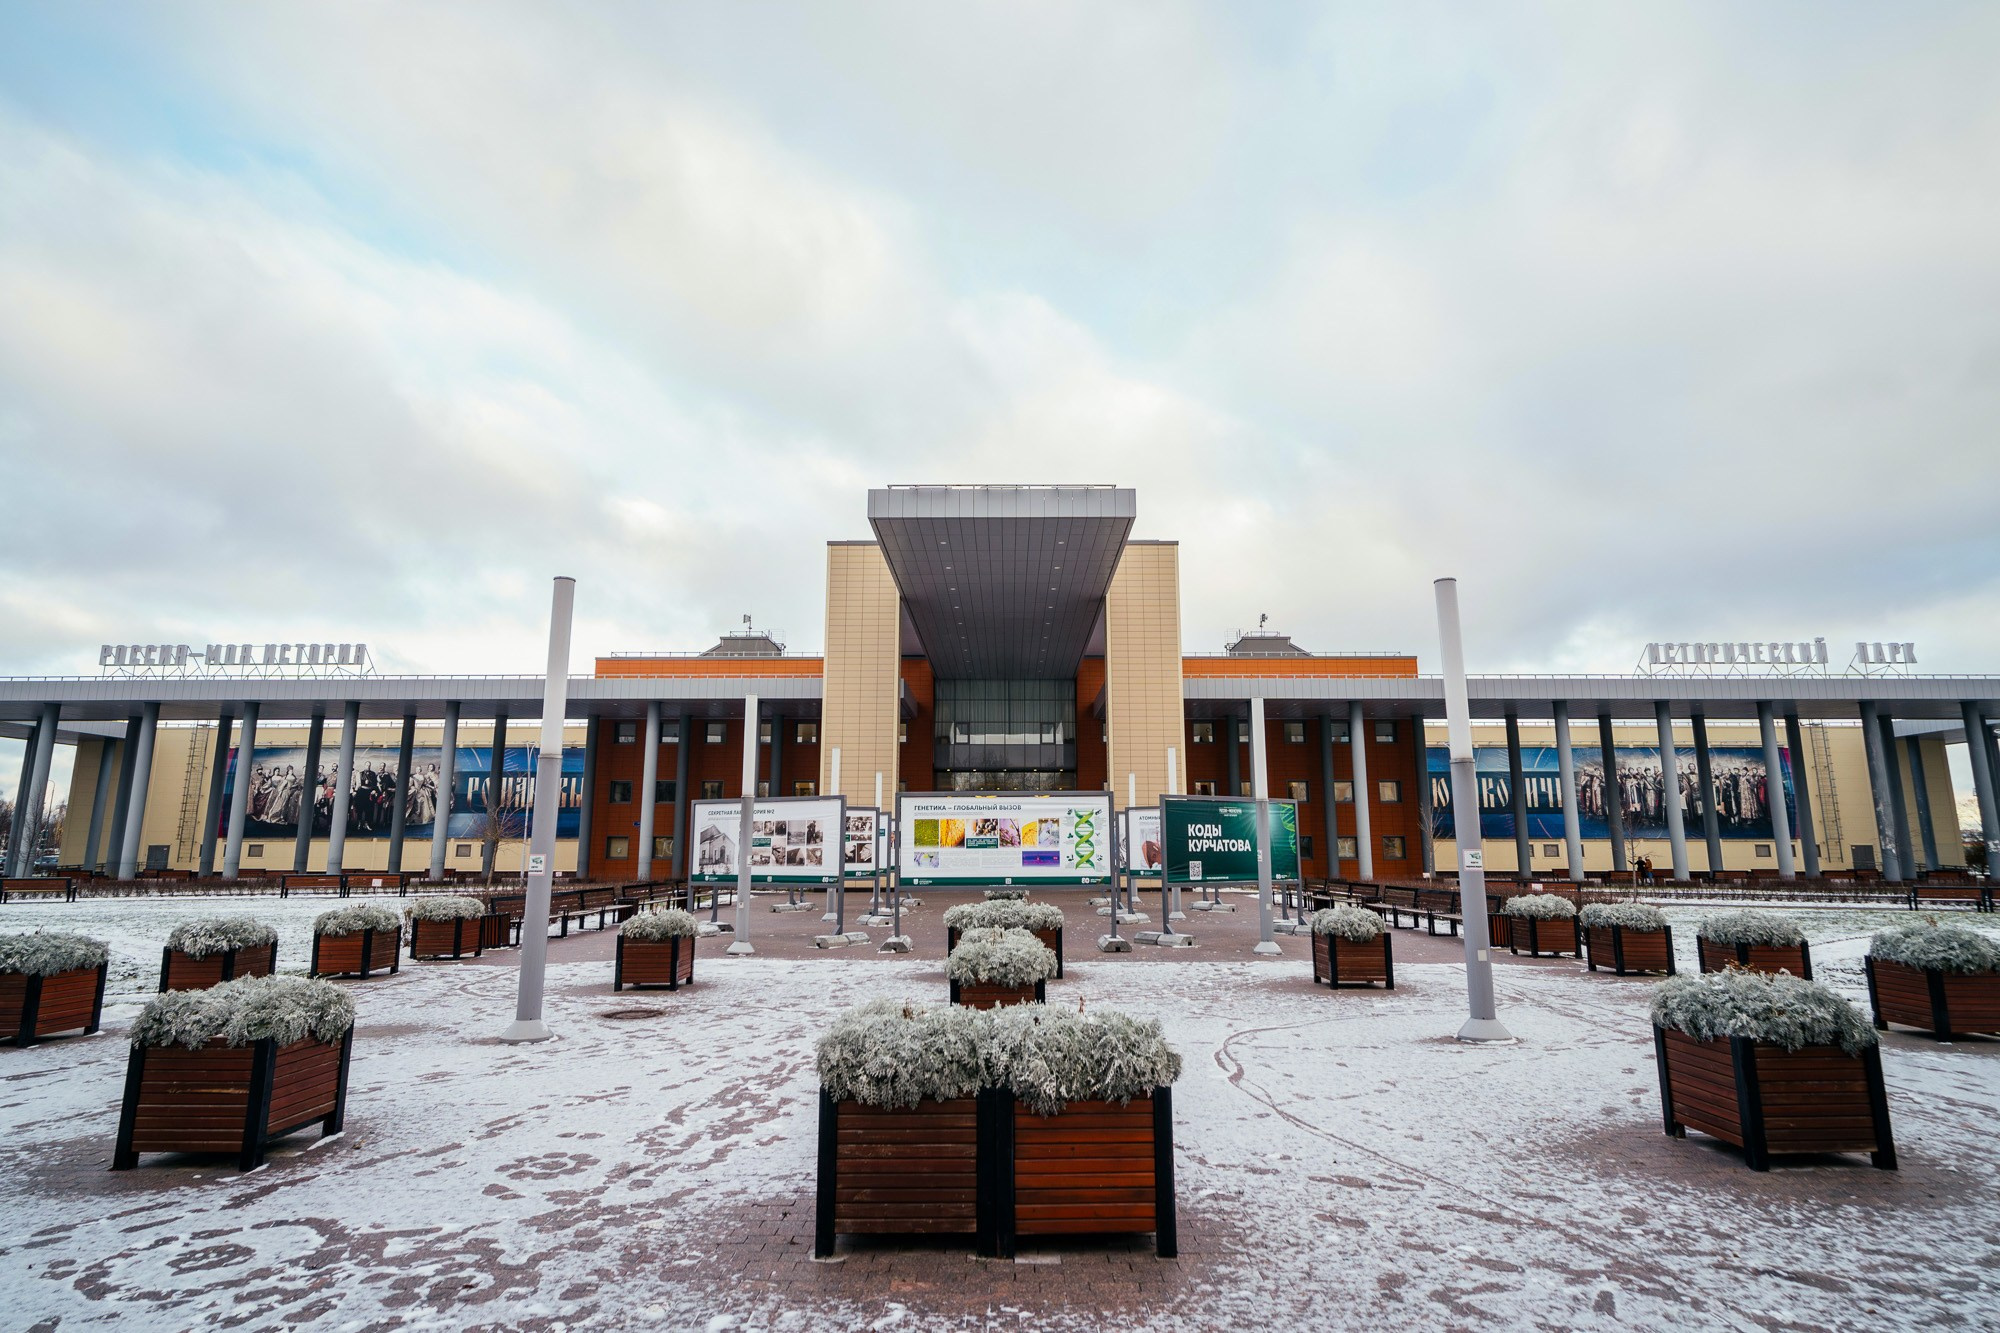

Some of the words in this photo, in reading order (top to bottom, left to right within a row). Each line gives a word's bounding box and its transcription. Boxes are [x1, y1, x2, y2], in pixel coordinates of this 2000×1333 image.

[263, 643, 366, 665] ИСТОРИЯ
[1647, 637, 1829, 664] ИСТОРИЧЕСКИЙ
[1856, 642, 1918, 664] ПАРК
[953, 803, 998, 811] ГЛОБАЛЬНЫЙ
[1187, 823, 1222, 839] КОДЫ
[1188, 839, 1252, 852] КУРЧАТОВА
